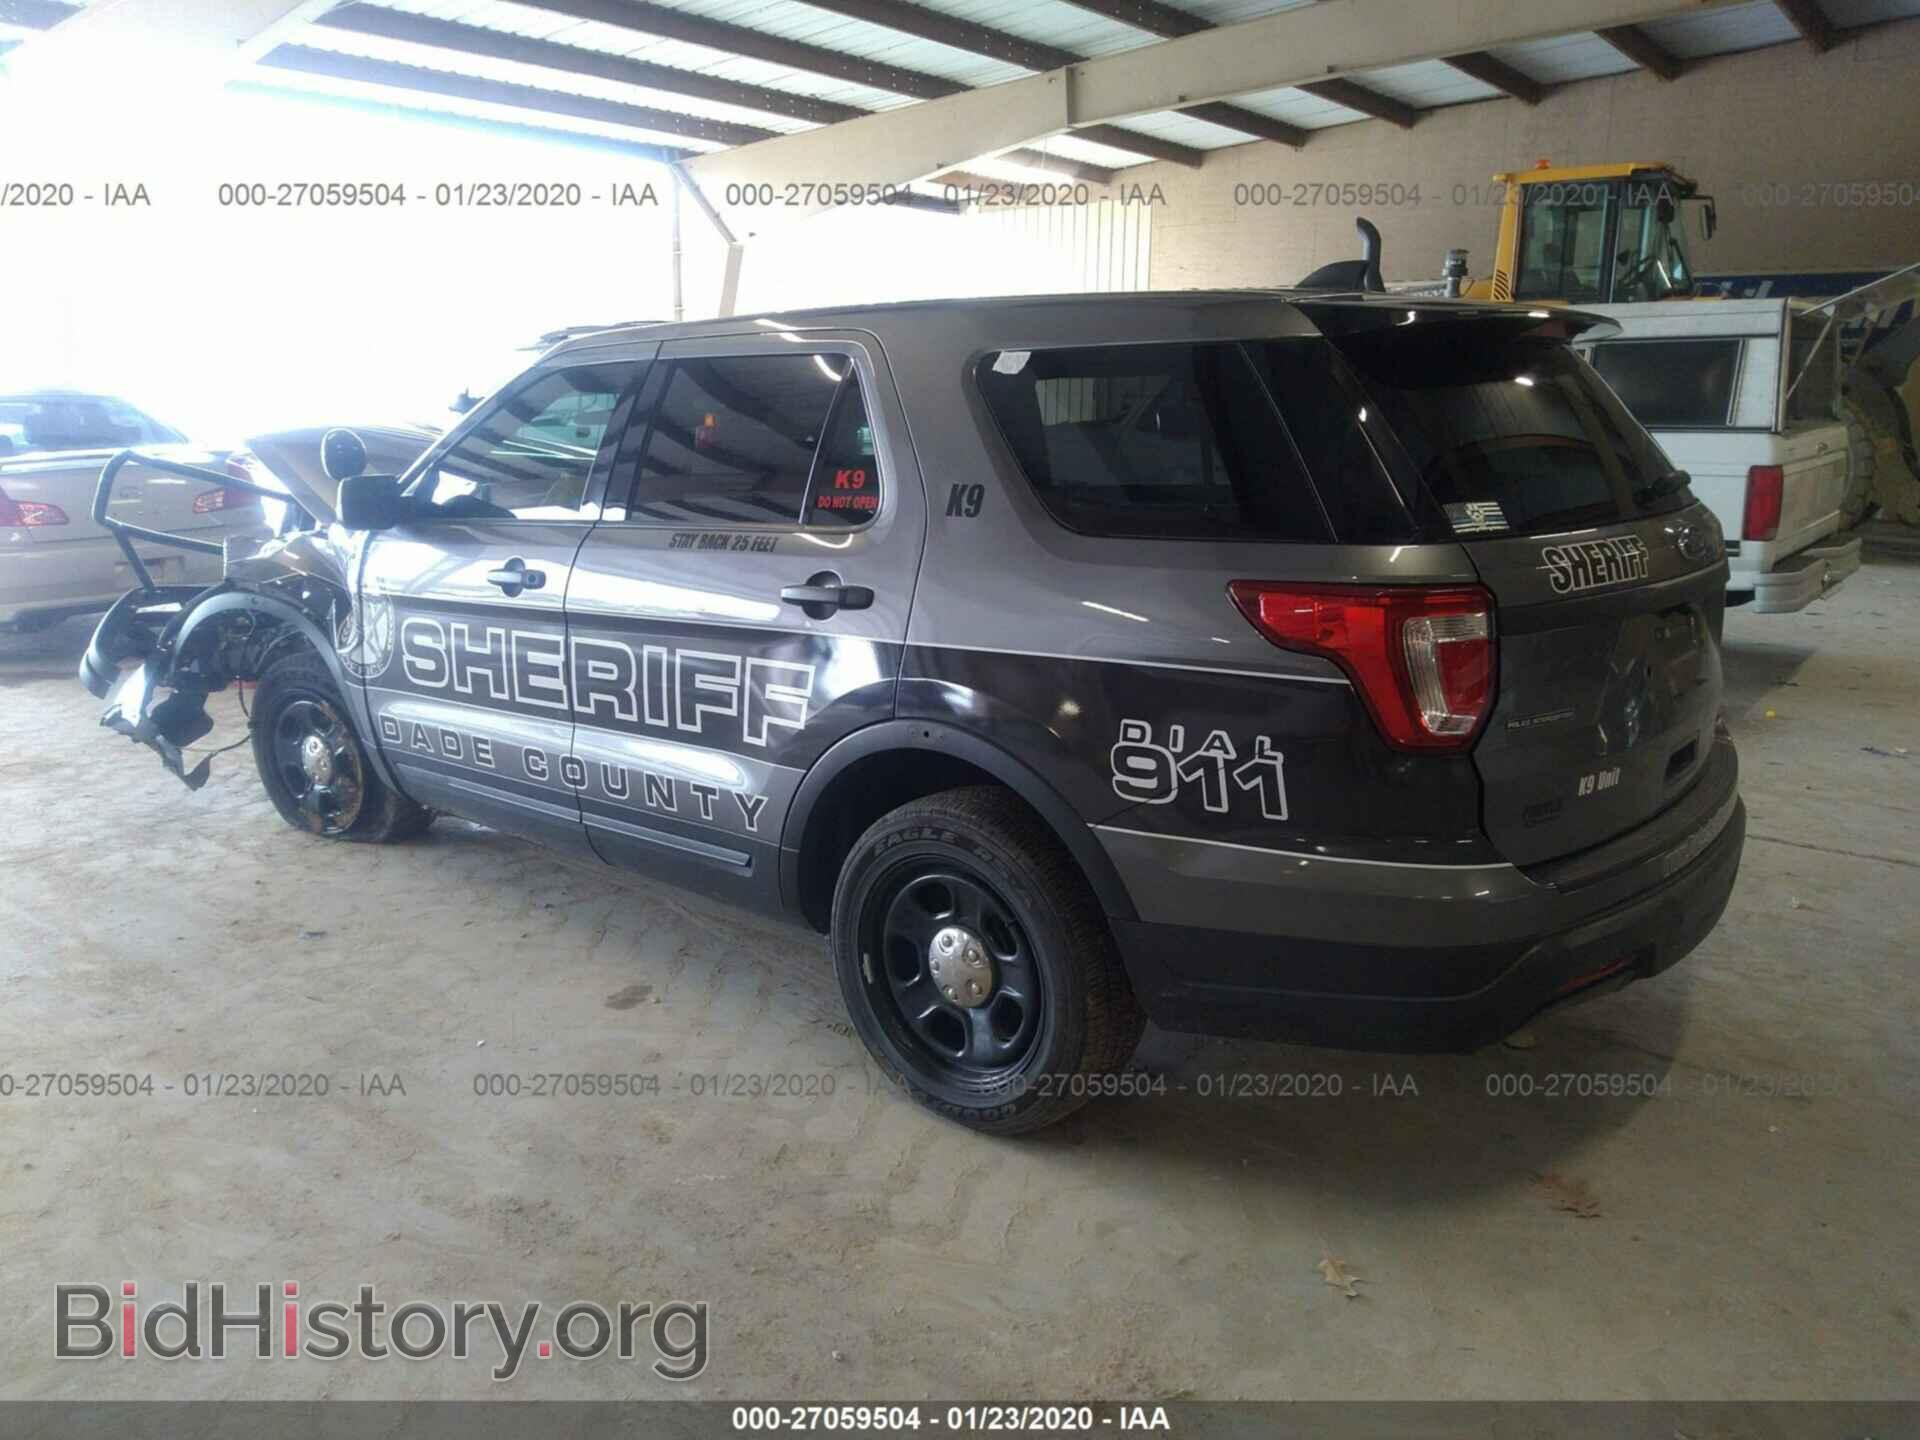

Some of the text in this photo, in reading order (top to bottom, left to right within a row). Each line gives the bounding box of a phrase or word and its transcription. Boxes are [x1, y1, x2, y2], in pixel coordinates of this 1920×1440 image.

[834, 470, 866, 489] K9
[816, 495, 878, 510] DO NOT OPEN
[945, 484, 985, 518] K9
[668, 532, 779, 553] STAY BACK 25 FEET
[1542, 534, 1649, 594] SHERIFF
[401, 618, 816, 748] SHERIFF
[1119, 718, 1285, 764] DIAL
[378, 711, 768, 832] DADE COUNTY
[1109, 740, 1289, 822] 911
[1578, 774, 1596, 797] K9
[873, 826, 959, 856] EAGLE
